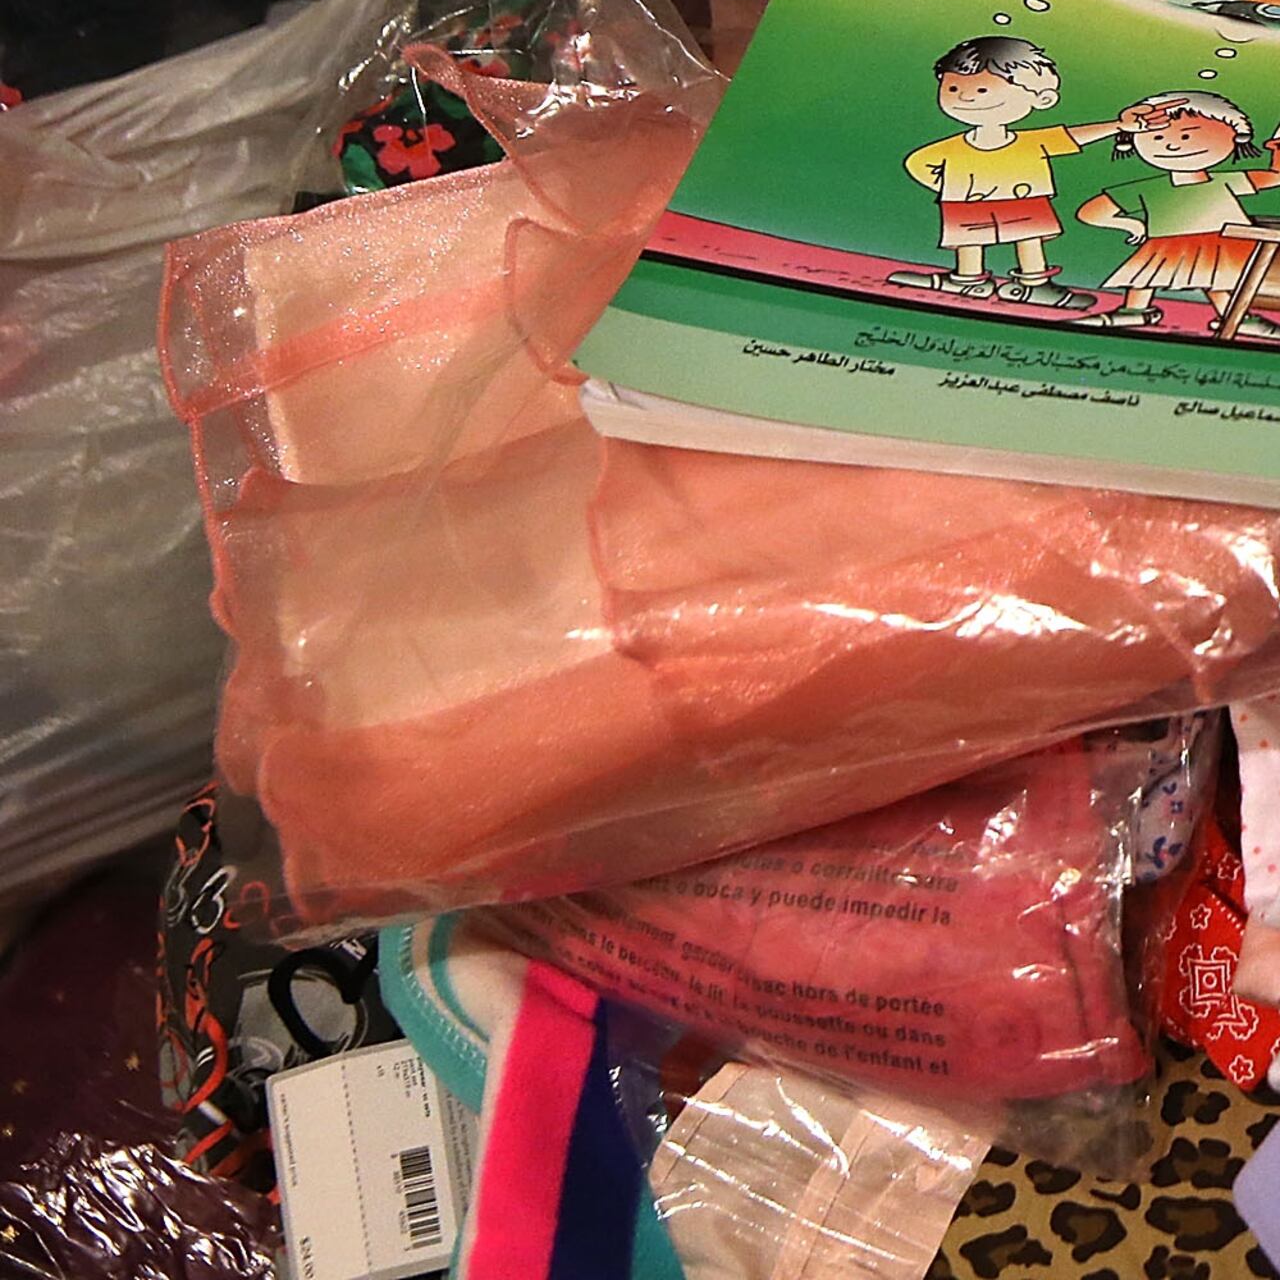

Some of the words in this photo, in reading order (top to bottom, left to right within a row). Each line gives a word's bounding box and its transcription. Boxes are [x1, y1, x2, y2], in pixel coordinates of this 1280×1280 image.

[768, 889, 836, 915] puede
[842, 896, 930, 925] impedir
[931, 906, 952, 925] la
[791, 980, 840, 1005] hors
[845, 987, 870, 1009] de
[894, 1022, 947, 1048] dans
